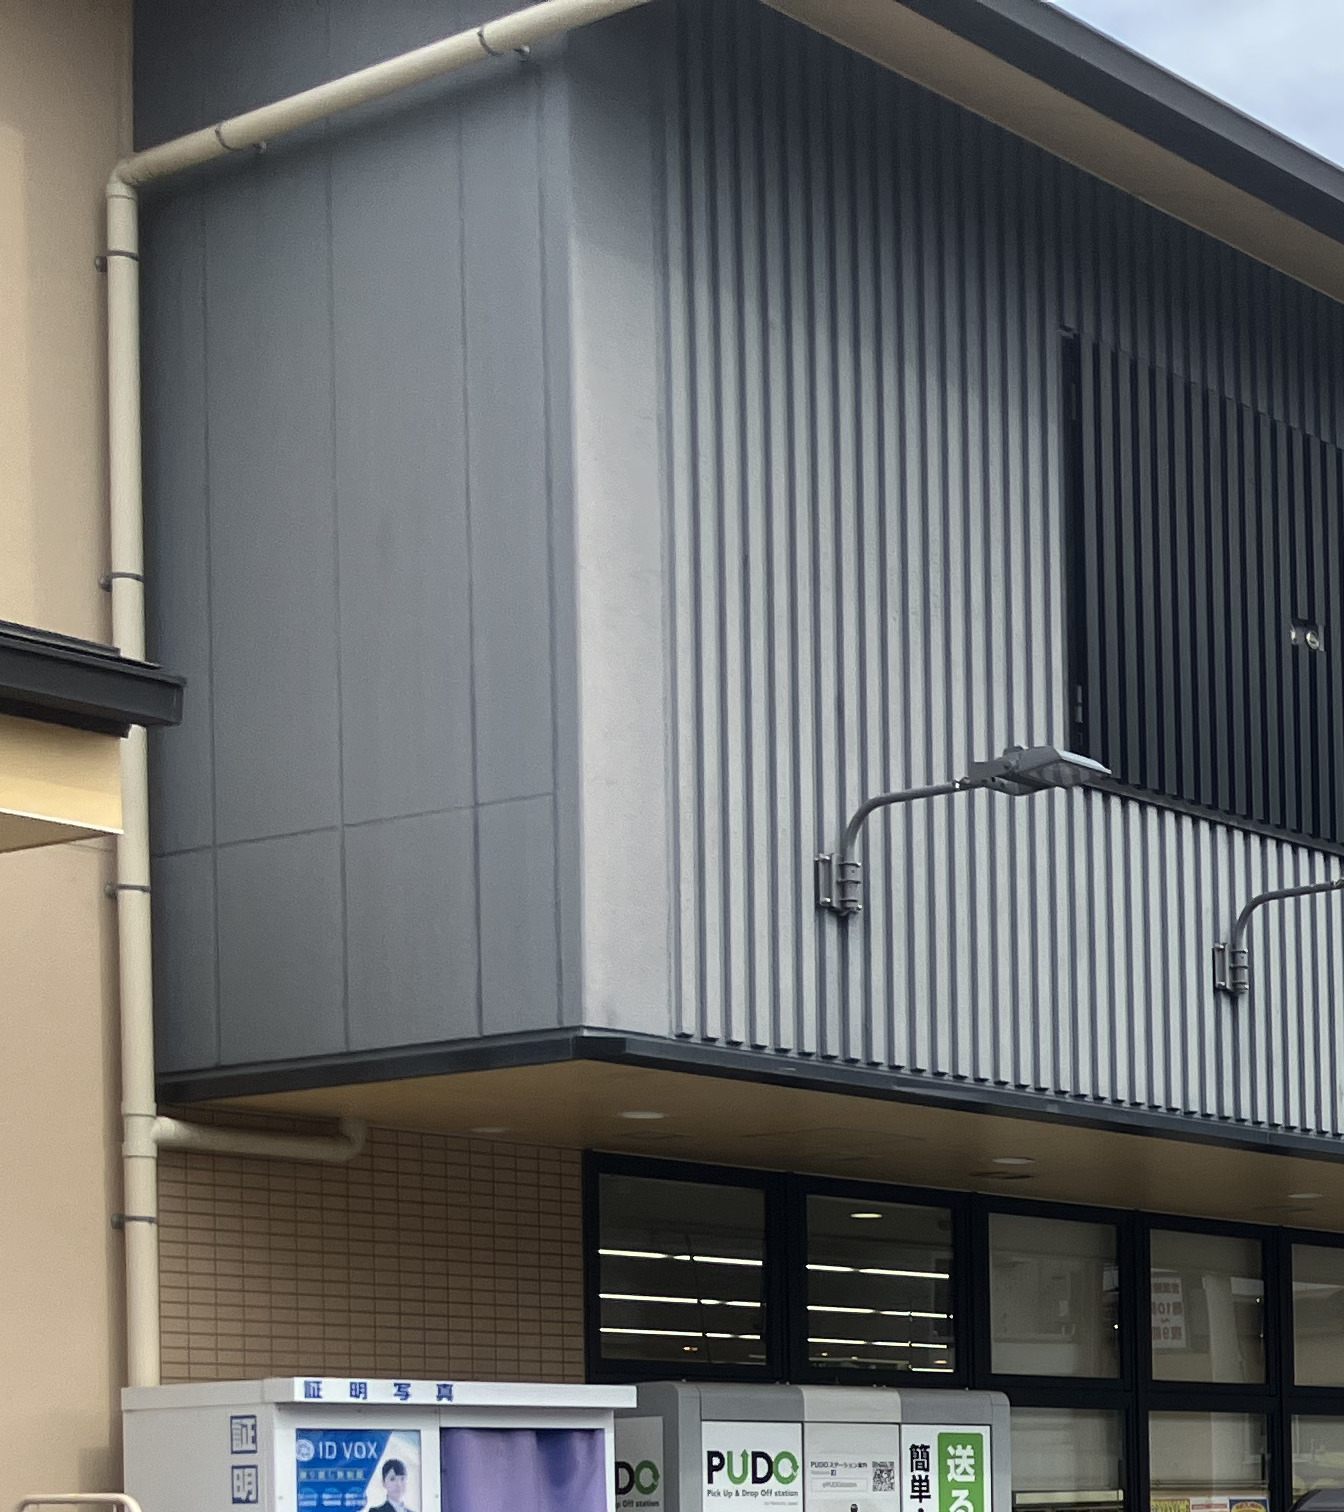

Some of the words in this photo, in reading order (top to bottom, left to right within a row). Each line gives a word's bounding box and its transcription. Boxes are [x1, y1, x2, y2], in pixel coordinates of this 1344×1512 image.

[304, 1380, 453, 1402] 証明写真
[319, 1442, 337, 1459] ID
[342, 1441, 378, 1460] VOX
[707, 1449, 799, 1485] PUDO
